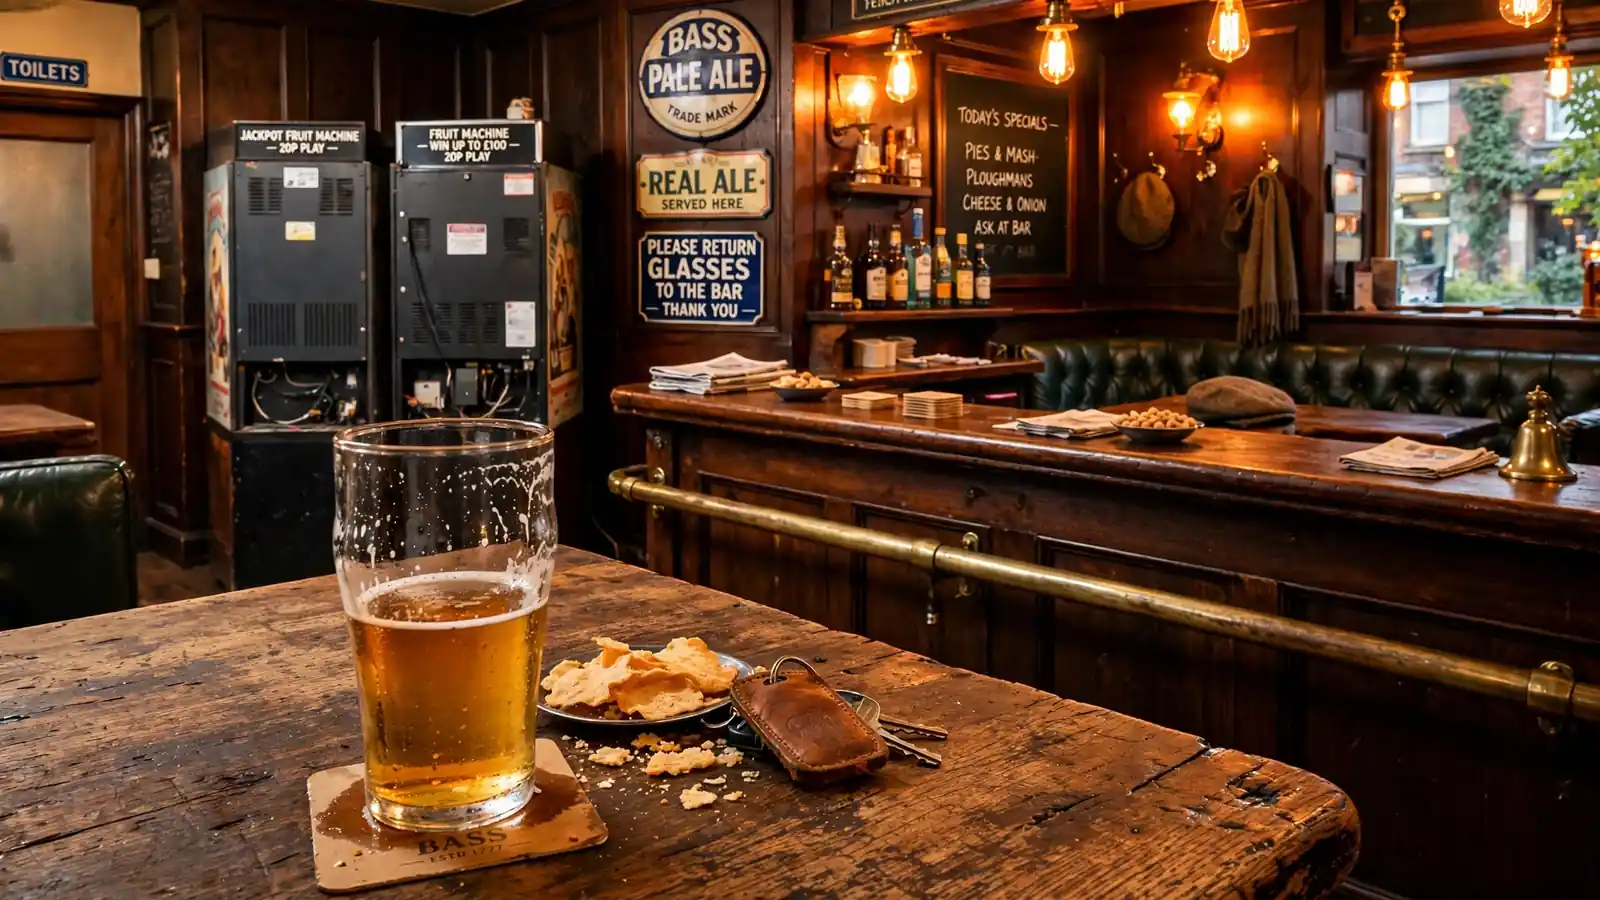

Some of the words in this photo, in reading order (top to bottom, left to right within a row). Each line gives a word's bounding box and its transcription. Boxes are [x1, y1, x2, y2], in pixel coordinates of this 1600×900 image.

[668, 22, 733, 56] BASS
[8, 59, 80, 81] TOILETS
[648, 61, 702, 94] PALE
[709, 58, 754, 90] ALE
[667, 104, 702, 123] TRADE
[705, 102, 738, 122] MARK
[958, 106, 1000, 127] TODAY'S
[240, 130, 283, 141] JACKPOT
[285, 130, 313, 141] FRUIT
[315, 130, 359, 142] MACHINE
[429, 128, 459, 139] FRUIT
[462, 128, 509, 139] MACHINE
[279, 143, 298, 154] 20P
[300, 143, 325, 154] PLAY
[429, 140, 449, 151] WIN
[452, 140, 466, 151] UP
[468, 140, 481, 150] TO
[483, 140, 507, 151] £100
[965, 142, 990, 160] PIES
[995, 146, 1002, 161] &
[444, 151, 463, 162] 20P
[465, 151, 491, 162] PLAY
[648, 169, 706, 195] REAL
[712, 168, 757, 194] ALE
[966, 168, 1033, 188] PLOUGHMANS
[662, 199, 707, 211] SERVED
[712, 198, 743, 209] HERE
[963, 194, 1002, 211] CHEESE
[1006, 196, 1013, 212] &
[1017, 196, 1047, 212] ONION
[974, 220, 995, 235] ASK
[997, 220, 1010, 235] AT
[1012, 220, 1032, 236] BAR
[647, 239, 698, 255] PLEASE
[702, 239, 756, 255] RETURN
[647, 257, 750, 280] GLASSES
[655, 282, 674, 299] TO
[677, 282, 706, 299] THE
[711, 283, 743, 300] BAR
[662, 302, 707, 317] THANK
[711, 303, 738, 318] YOU
[417, 828, 507, 855] BASS
